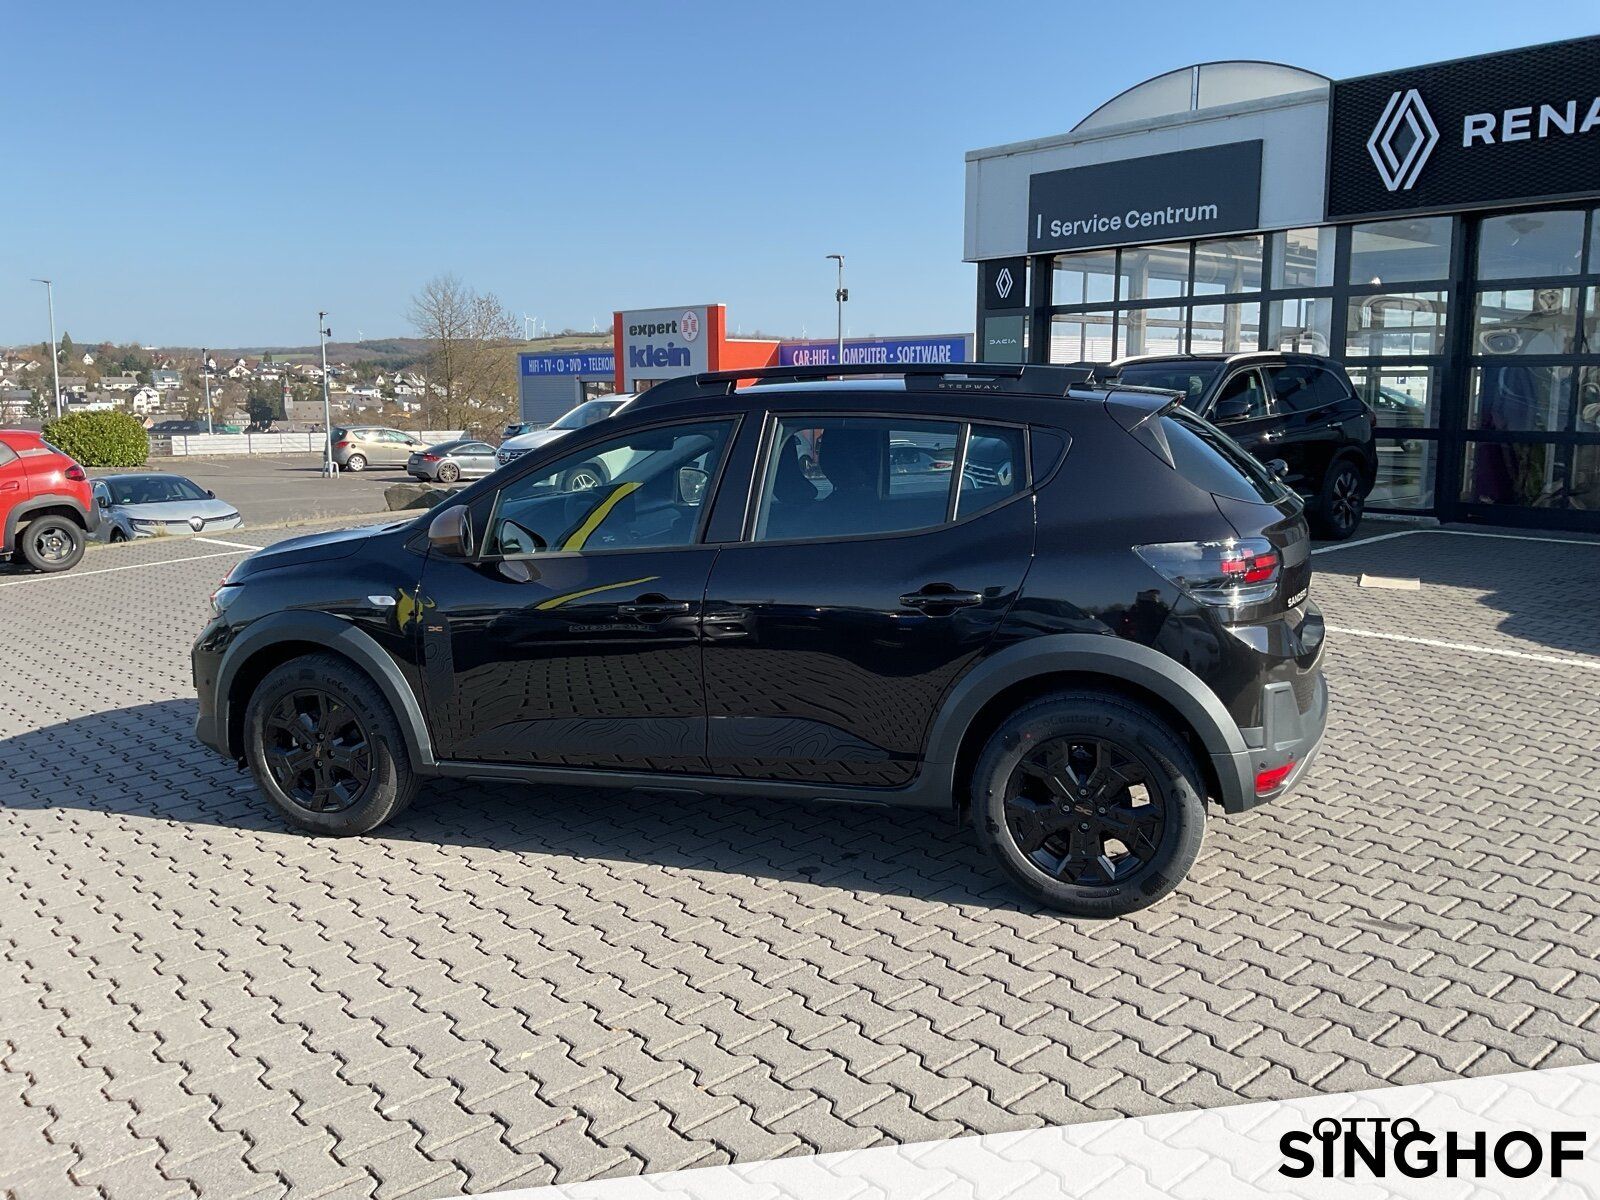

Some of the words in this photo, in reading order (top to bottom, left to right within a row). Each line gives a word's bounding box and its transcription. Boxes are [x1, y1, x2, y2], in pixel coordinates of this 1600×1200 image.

[1050, 214, 1121, 237] Service
[1125, 204, 1217, 229] Centrum
[629, 320, 677, 337] expert
[629, 341, 691, 368] klein
[793, 350, 829, 366] CAR-HIFI
[842, 347, 887, 364] OMPUTER
[897, 345, 951, 363] SOFTWARE
[529, 359, 540, 373] HIFI
[544, 358, 552, 372] TV
[570, 357, 581, 372] DVD
[1105, 717, 1114, 728] 7
